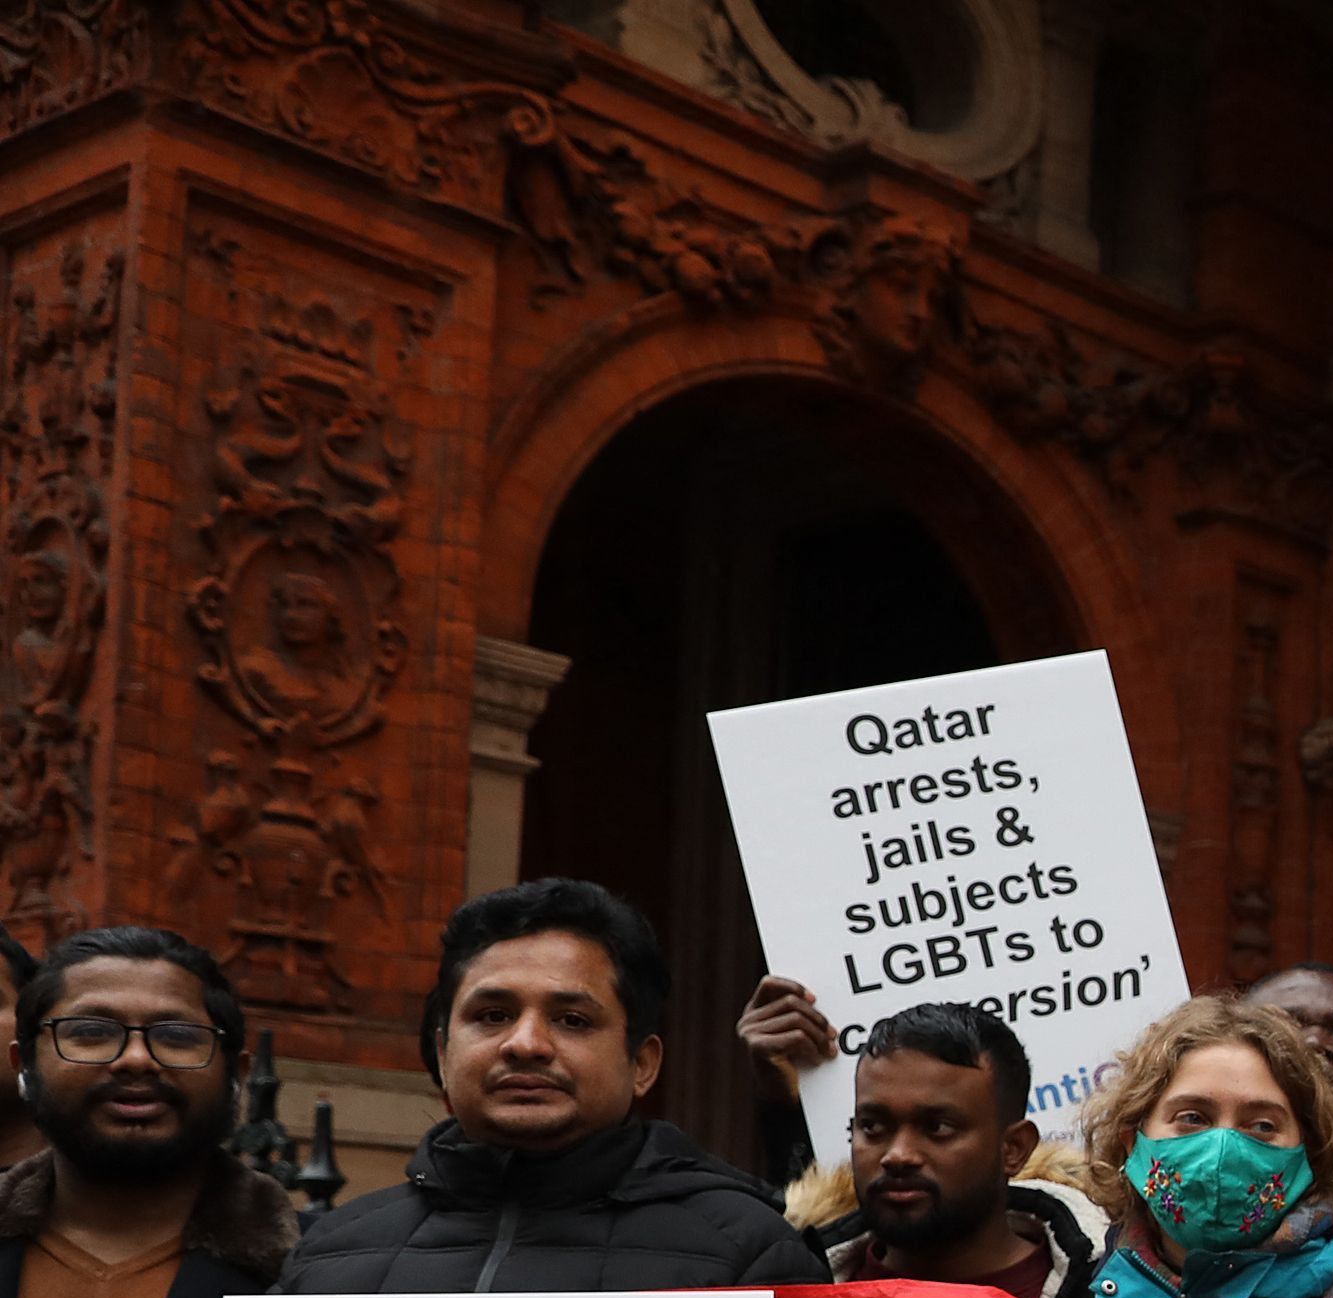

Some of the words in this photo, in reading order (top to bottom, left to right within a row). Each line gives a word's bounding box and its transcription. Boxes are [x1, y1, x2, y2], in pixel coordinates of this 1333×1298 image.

[847, 705, 994, 755] Qatar
[832, 756, 1038, 818] arrests,
[862, 821, 975, 884] jails
[997, 807, 1034, 846] &
[846, 863, 1077, 933] subjects
[845, 927, 1034, 994] LGBTs
[1050, 916, 1103, 952] to
[838, 955, 1150, 1056] cersion’
